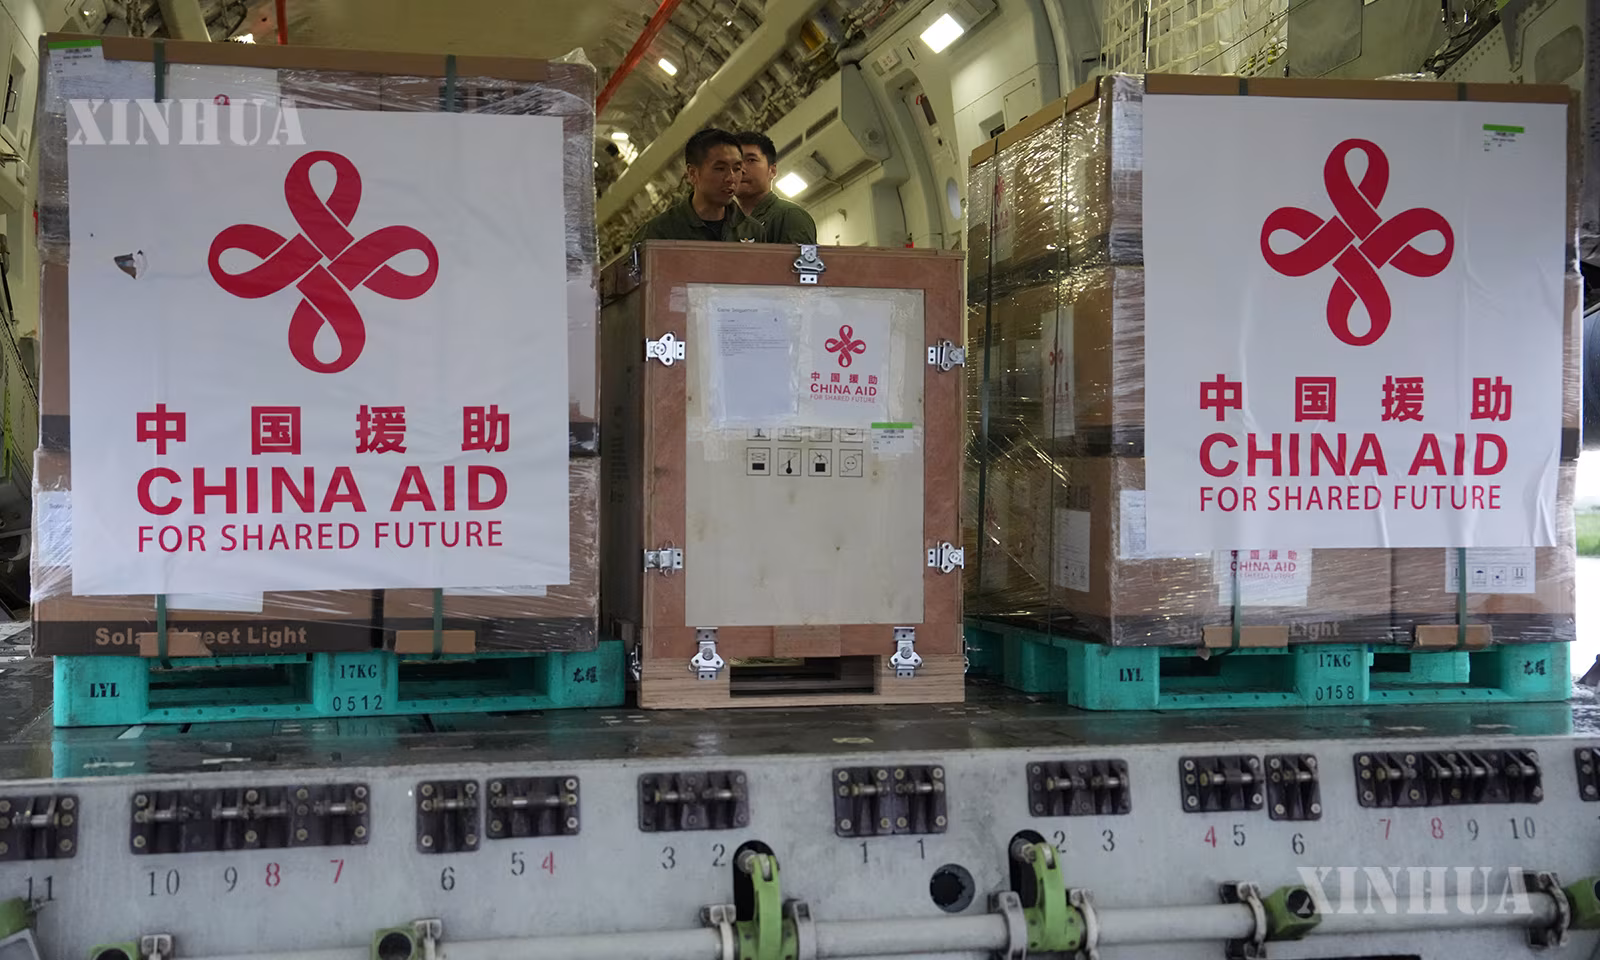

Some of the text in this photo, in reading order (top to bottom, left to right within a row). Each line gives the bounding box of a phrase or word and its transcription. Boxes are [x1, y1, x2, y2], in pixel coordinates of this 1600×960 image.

[810, 371, 878, 385] 中国援助
[810, 383, 877, 397] CHINA AID
[824, 394, 850, 402] SHARED
[1199, 373, 1513, 423] 中国援助
[136, 403, 511, 455] 中国援助
[1199, 432, 1509, 478] CHINA AID
[137, 465, 509, 516] CHINA AID
[1199, 485, 1501, 512] FOR SHARED FUTURE
[138, 520, 503, 553] FOR SHARED FUTURE
[1230, 561, 1297, 572] CHINA AID
[95, 627, 142, 646] Sola
[247, 626, 307, 648] Light
[1290, 621, 1340, 640] Light
[340, 664, 377, 679] 17KG
[1319, 653, 1351, 668] 17KG
[1119, 668, 1144, 682] LYL
[90, 683, 120, 698] LYL
[1315, 685, 1355, 701] 0158
[333, 694, 383, 712] 0512
[1204, 824, 1246, 848] 4 5
[1379, 817, 1536, 841] 7 8 9 10
[861, 838, 925, 864] 1 1
[1053, 829, 1116, 854] 2 3
[1292, 832, 1305, 855] 6
[511, 851, 556, 876] 5 4
[661, 843, 726, 870] 3 2
[25, 875, 55, 901] 11
[148, 859, 345, 897] 10 9 8 7
[440, 866, 456, 891] 6
